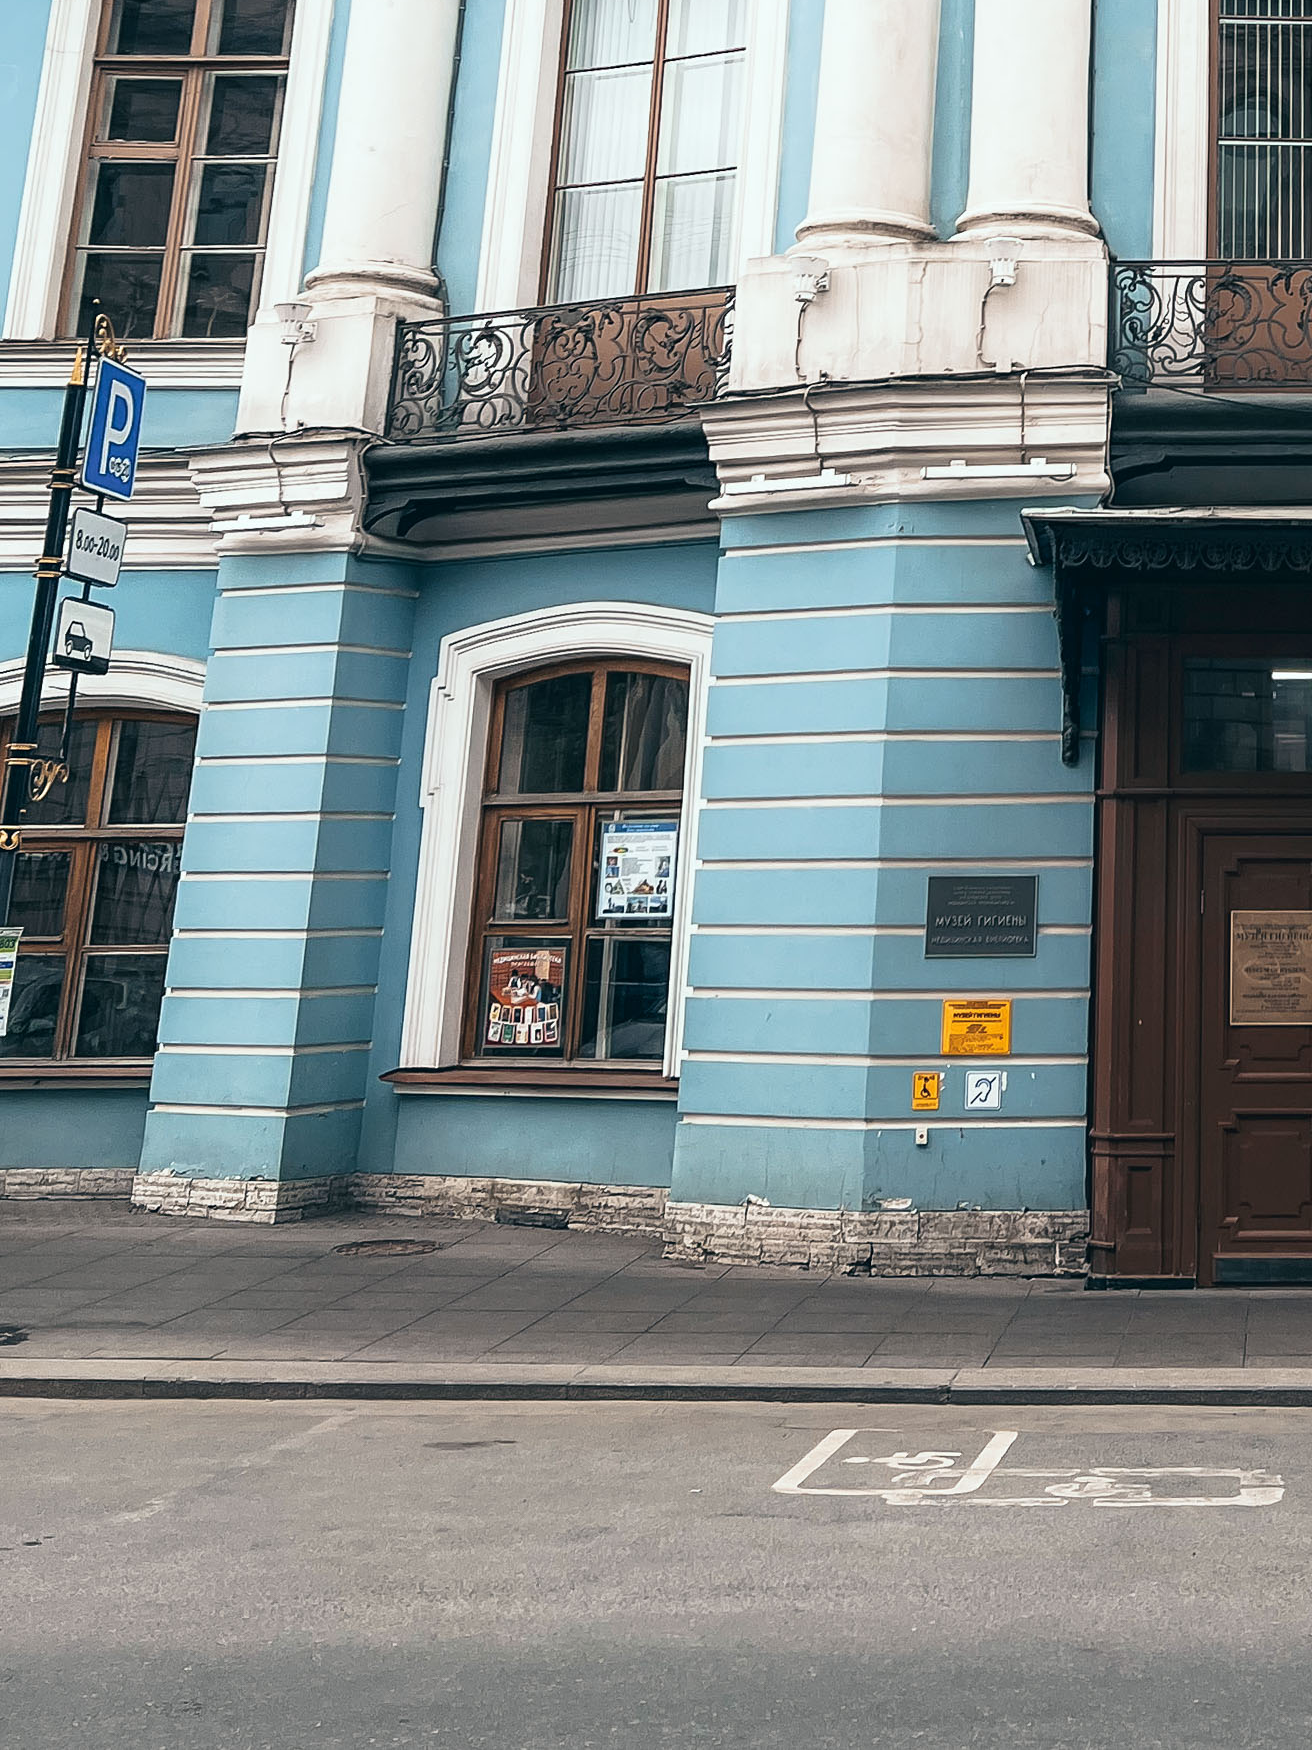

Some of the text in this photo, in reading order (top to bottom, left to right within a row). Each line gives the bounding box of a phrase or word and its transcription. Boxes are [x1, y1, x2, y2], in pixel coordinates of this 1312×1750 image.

[100, 379, 134, 475] P
[75, 529, 120, 562] 8.00-20.00
[935, 914, 1027, 927] МУЗЕЙ ГИГИЕНЫ
